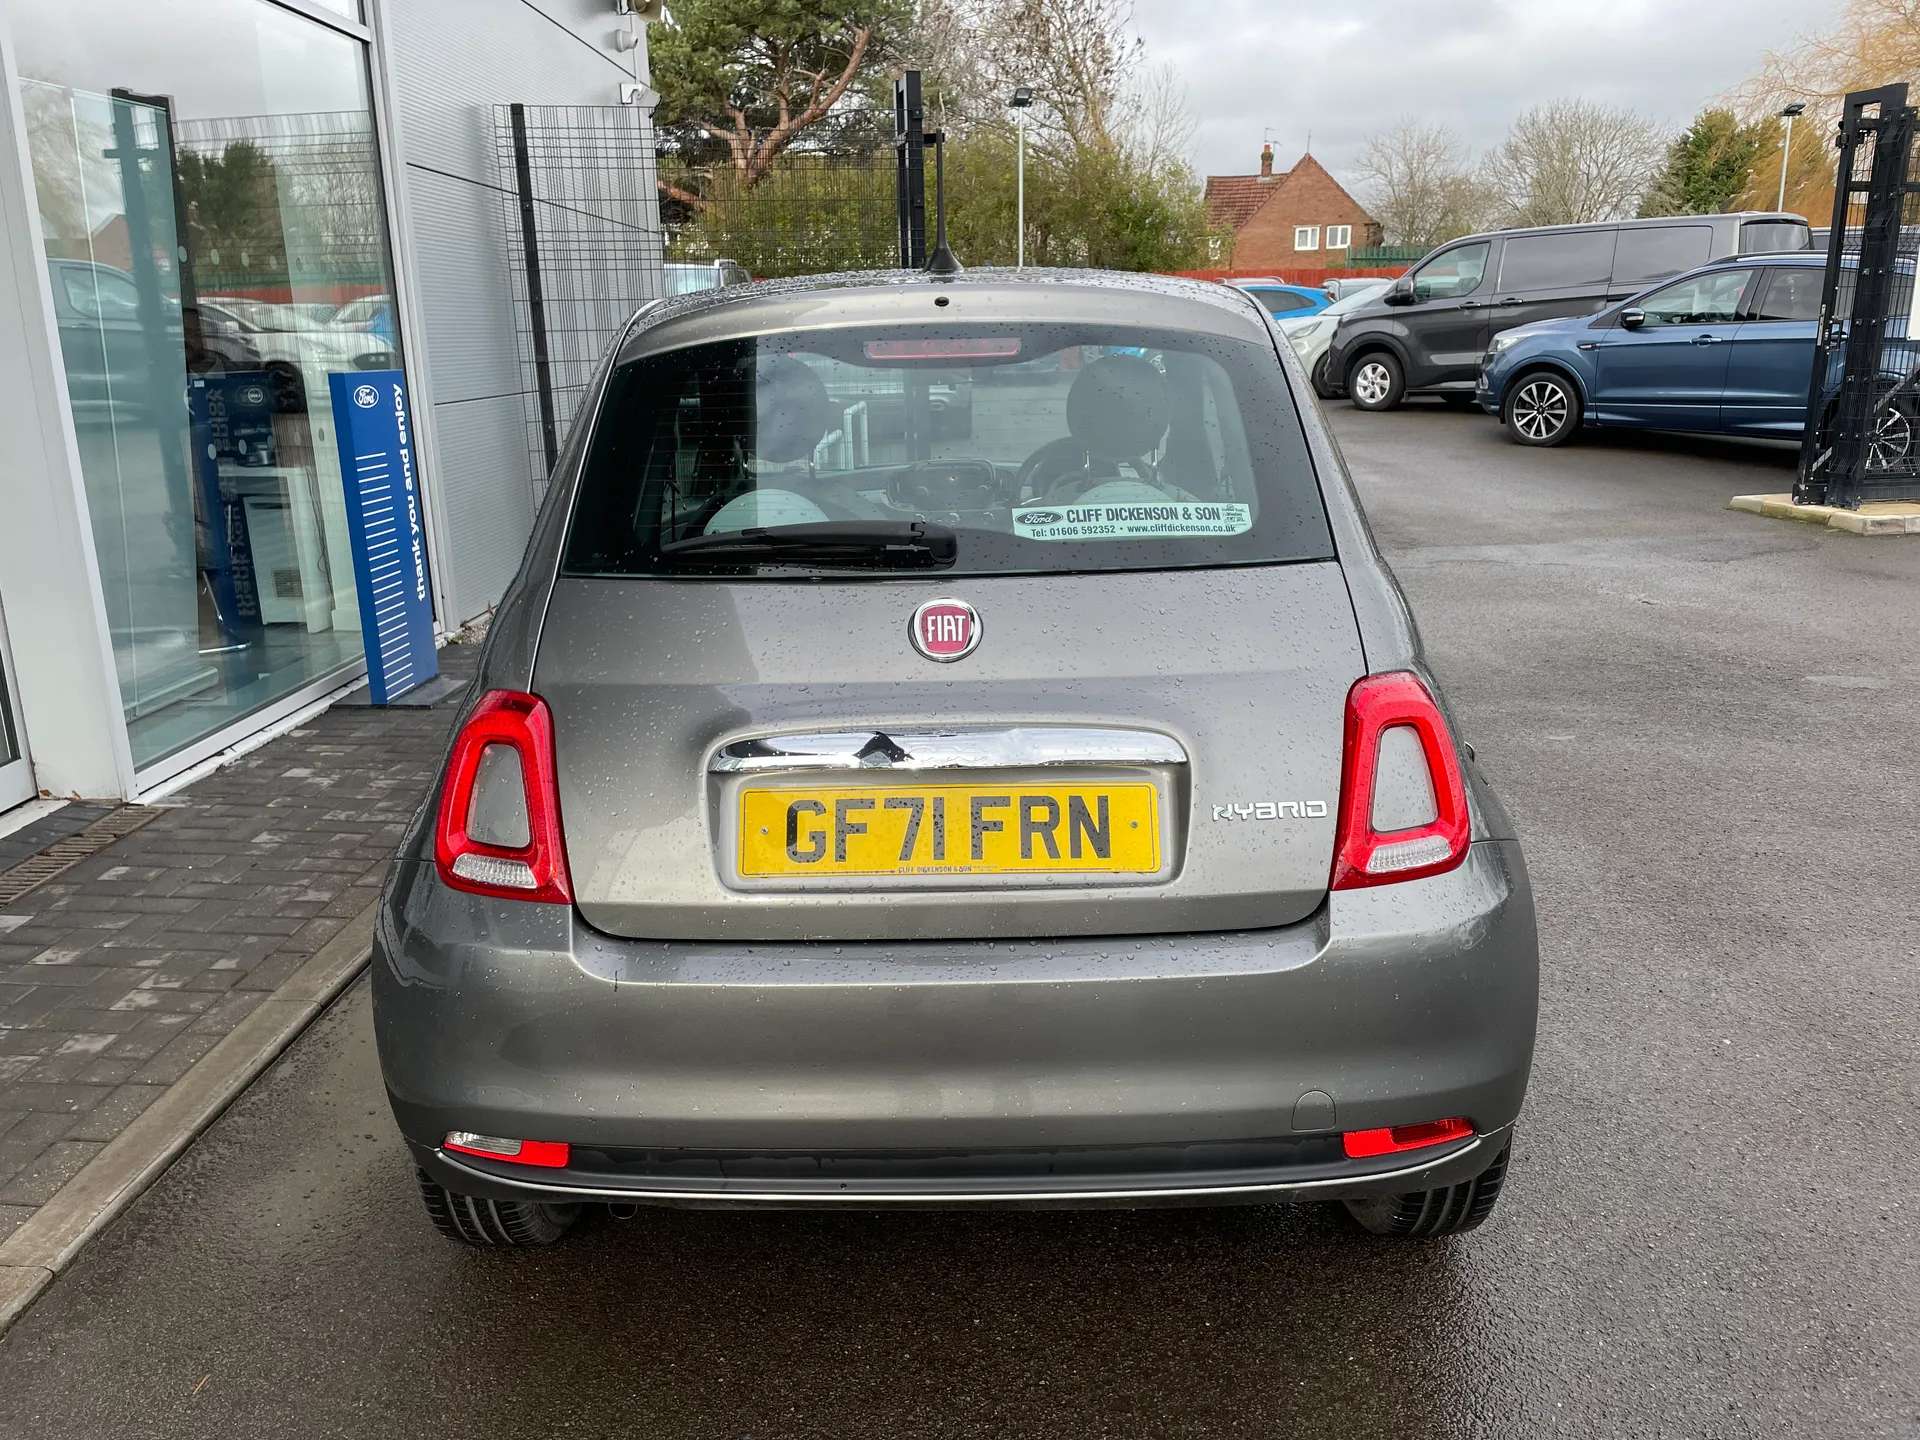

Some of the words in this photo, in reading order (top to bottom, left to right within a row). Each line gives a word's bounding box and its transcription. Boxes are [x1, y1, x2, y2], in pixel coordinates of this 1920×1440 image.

[359, 388, 375, 405] Ford
[393, 383, 407, 445] enjoy
[400, 448, 413, 492] and
[407, 494, 420, 536] you
[1024, 512, 1054, 524] Ford
[1066, 508, 1102, 523] CLIFF
[1105, 506, 1179, 522] DICKENSON
[1182, 506, 1193, 520] &
[1195, 506, 1221, 521] SON
[1031, 528, 1048, 538] Tel:
[1049, 527, 1079, 537] 01606
[1081, 524, 1117, 535] 592352
[1127, 522, 1236, 533] www.cliffdickenson.co.uk
[412, 537, 426, 601] thank
[927, 614, 966, 643] FIAT
[1211, 800, 1328, 821] HYBRID
[785, 796, 945, 863] GF71
[970, 795, 1112, 860] FRN
